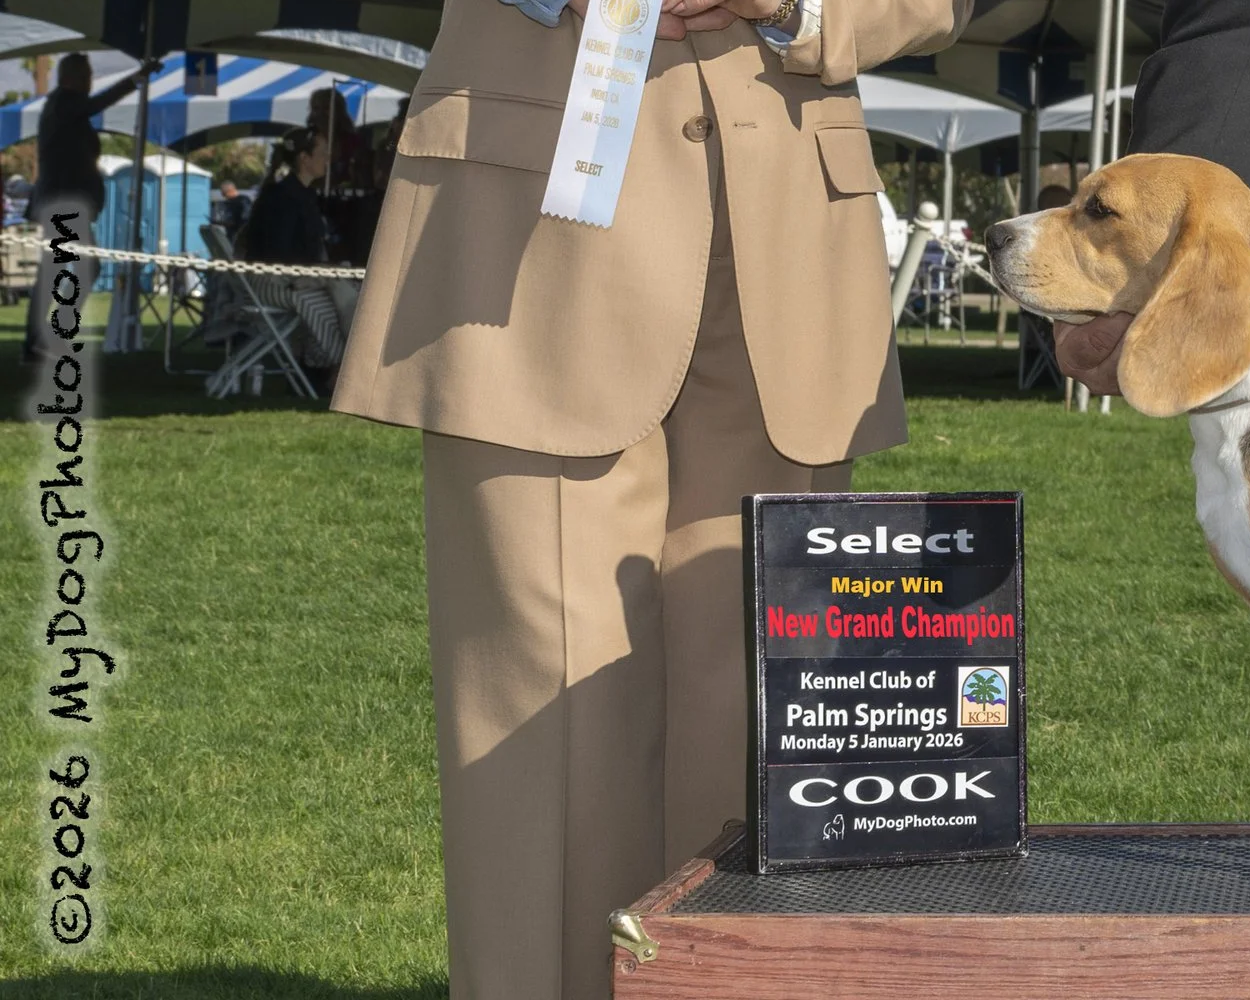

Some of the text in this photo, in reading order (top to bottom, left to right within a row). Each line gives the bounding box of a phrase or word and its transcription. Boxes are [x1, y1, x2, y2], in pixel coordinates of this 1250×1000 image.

[585, 38, 611, 56] KENNEL
[635, 49, 646, 62] OF
[584, 62, 604, 78] PALM
[575, 159, 604, 176] SELECT
[806, 526, 974, 554] Select
[831, 576, 944, 597] Major Win
[767, 605, 1014, 646] New Grand Champion
[800, 670, 936, 689] Kennel Club of
[787, 702, 947, 732] Palm Springs
[968, 711, 1001, 723] KCPS
[780, 732, 964, 753] Monday 5 January 2026
[789, 770, 996, 807] COOK
[854, 814, 977, 832] MyDogPhoto.com
